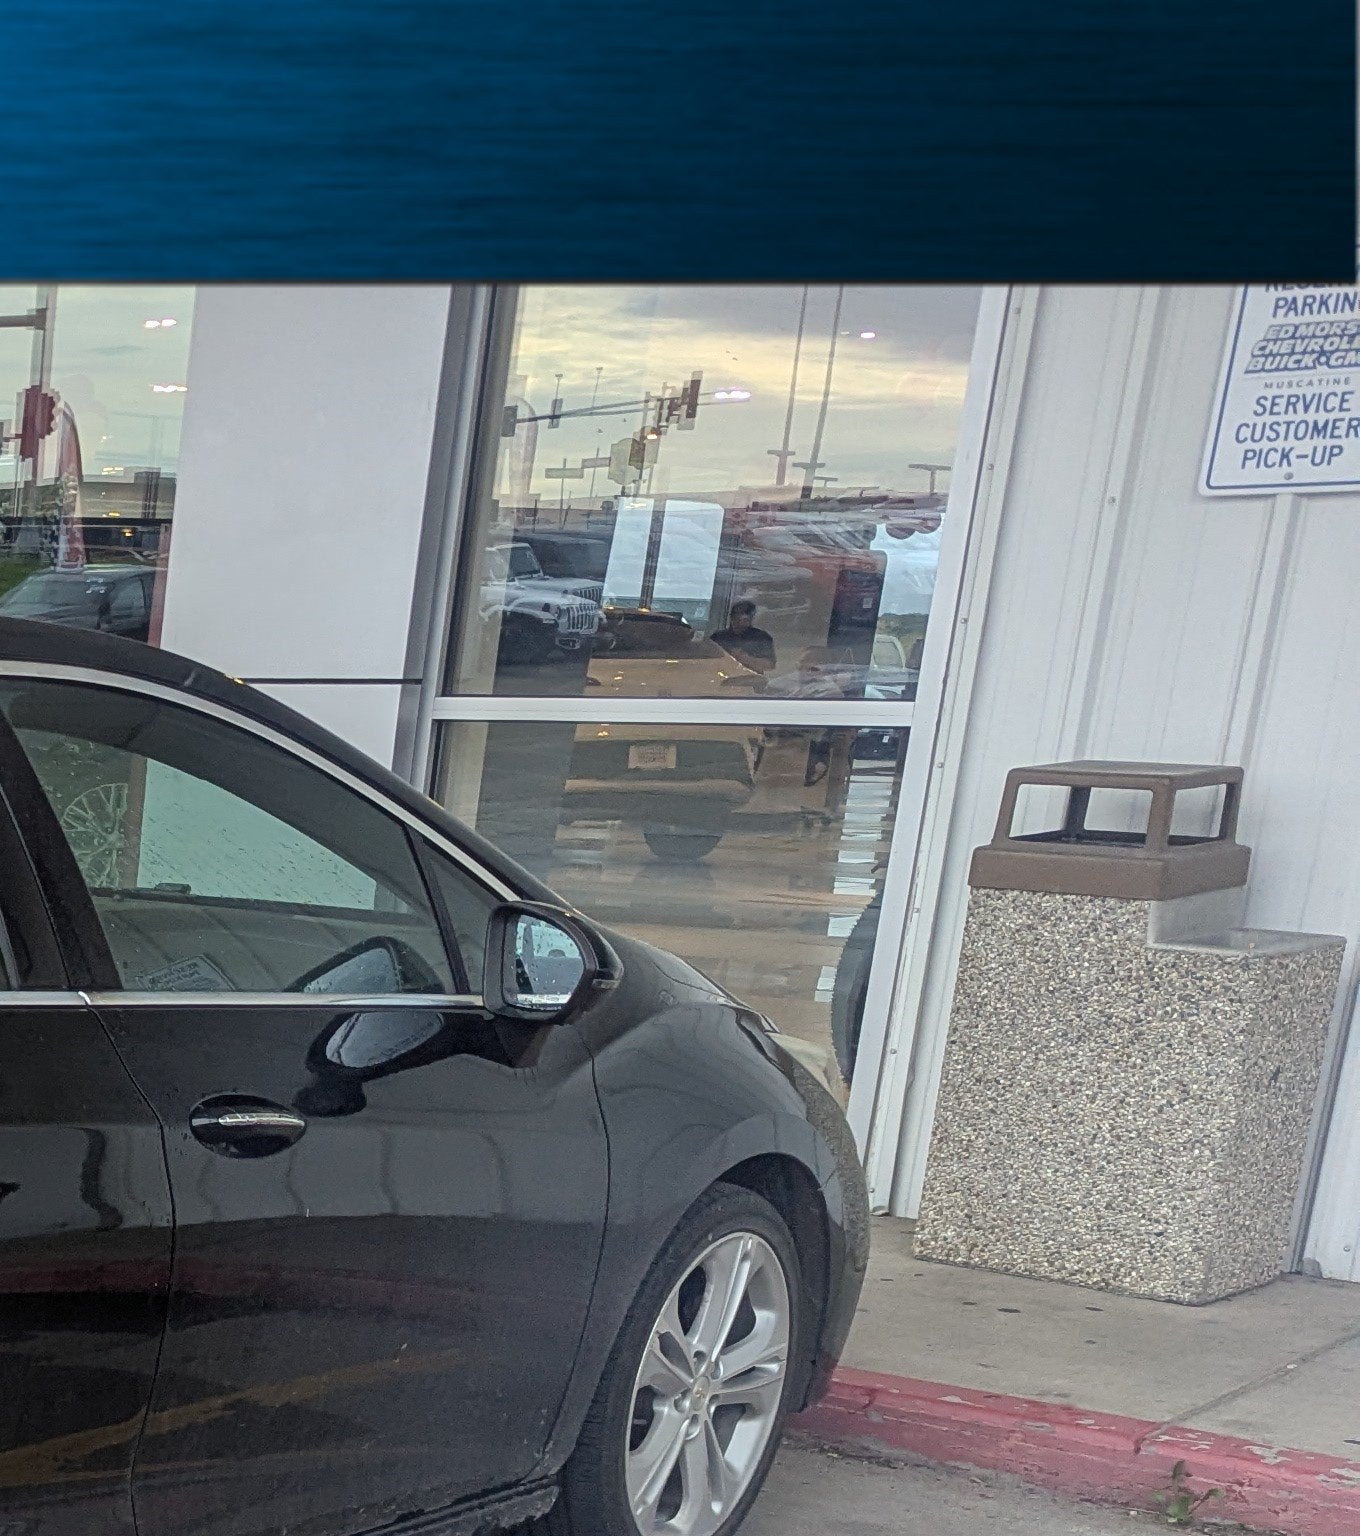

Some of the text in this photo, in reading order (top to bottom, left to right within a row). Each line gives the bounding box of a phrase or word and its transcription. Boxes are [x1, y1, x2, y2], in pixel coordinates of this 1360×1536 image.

[1272, 291, 1360, 318] PARKIN
[1264, 324, 1295, 340] ED
[1264, 377, 1350, 389] MUSCATINE
[1253, 390, 1355, 417] SERVICE
[1235, 417, 1360, 444] CUSTOMER
[1241, 444, 1344, 469] PICK-UP
